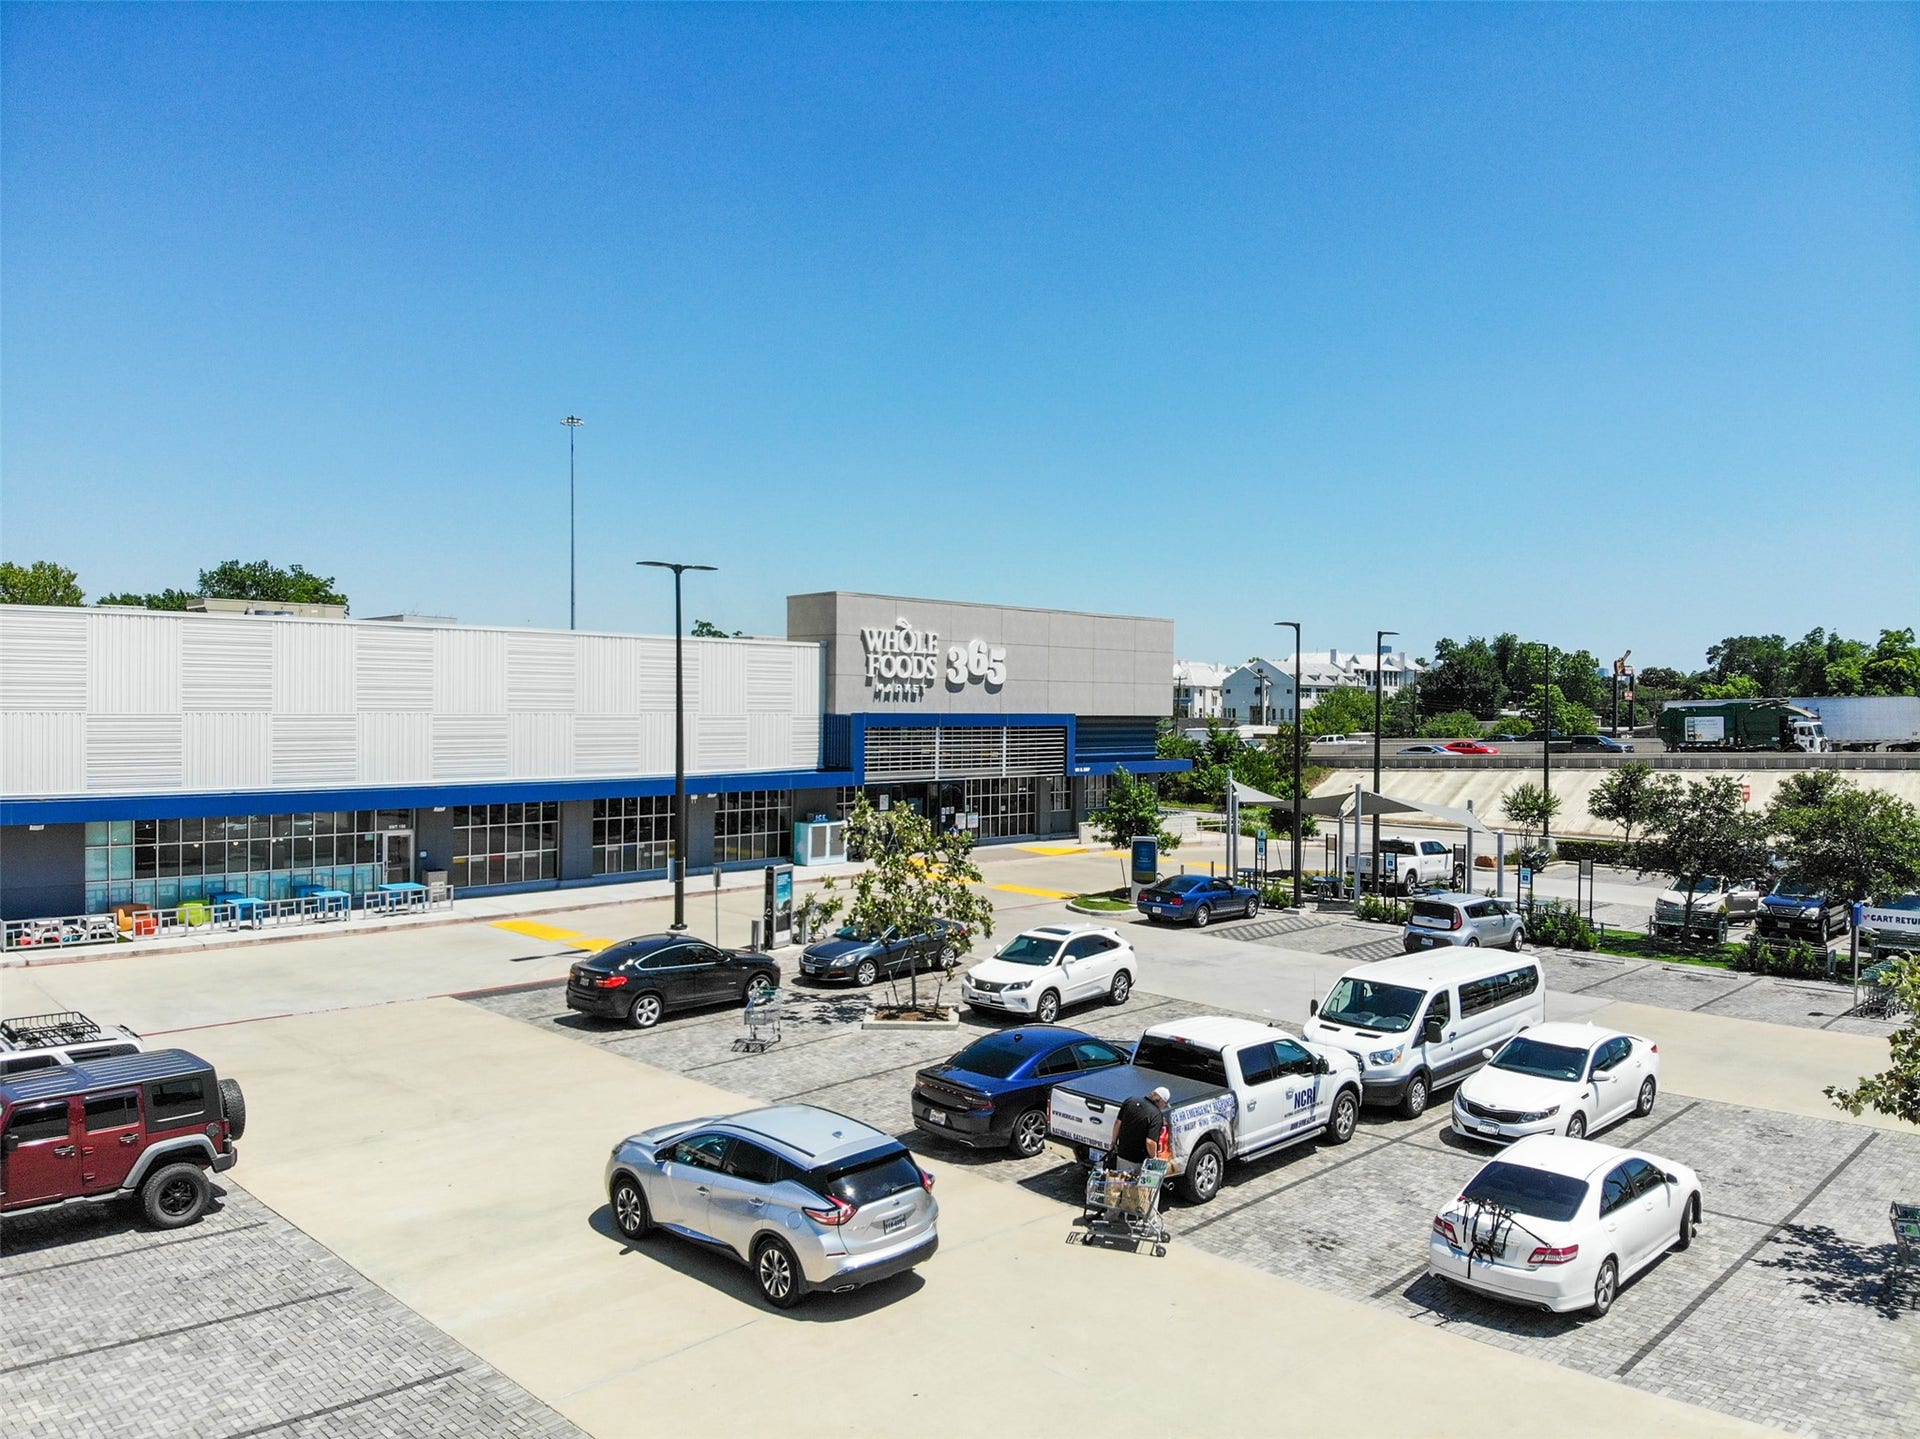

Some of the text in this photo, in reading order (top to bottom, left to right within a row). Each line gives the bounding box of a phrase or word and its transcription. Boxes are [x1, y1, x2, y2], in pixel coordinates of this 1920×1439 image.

[861, 627, 939, 654] WHOLE
[865, 653, 938, 679] FOODS
[946, 639, 1007, 685] 365
[1870, 914, 1894, 923] CART
[1294, 1086, 1316, 1109] NCRI
[1186, 1103, 1212, 1119] EMERGENCY
[1052, 1127, 1073, 1139] NATIONAL
